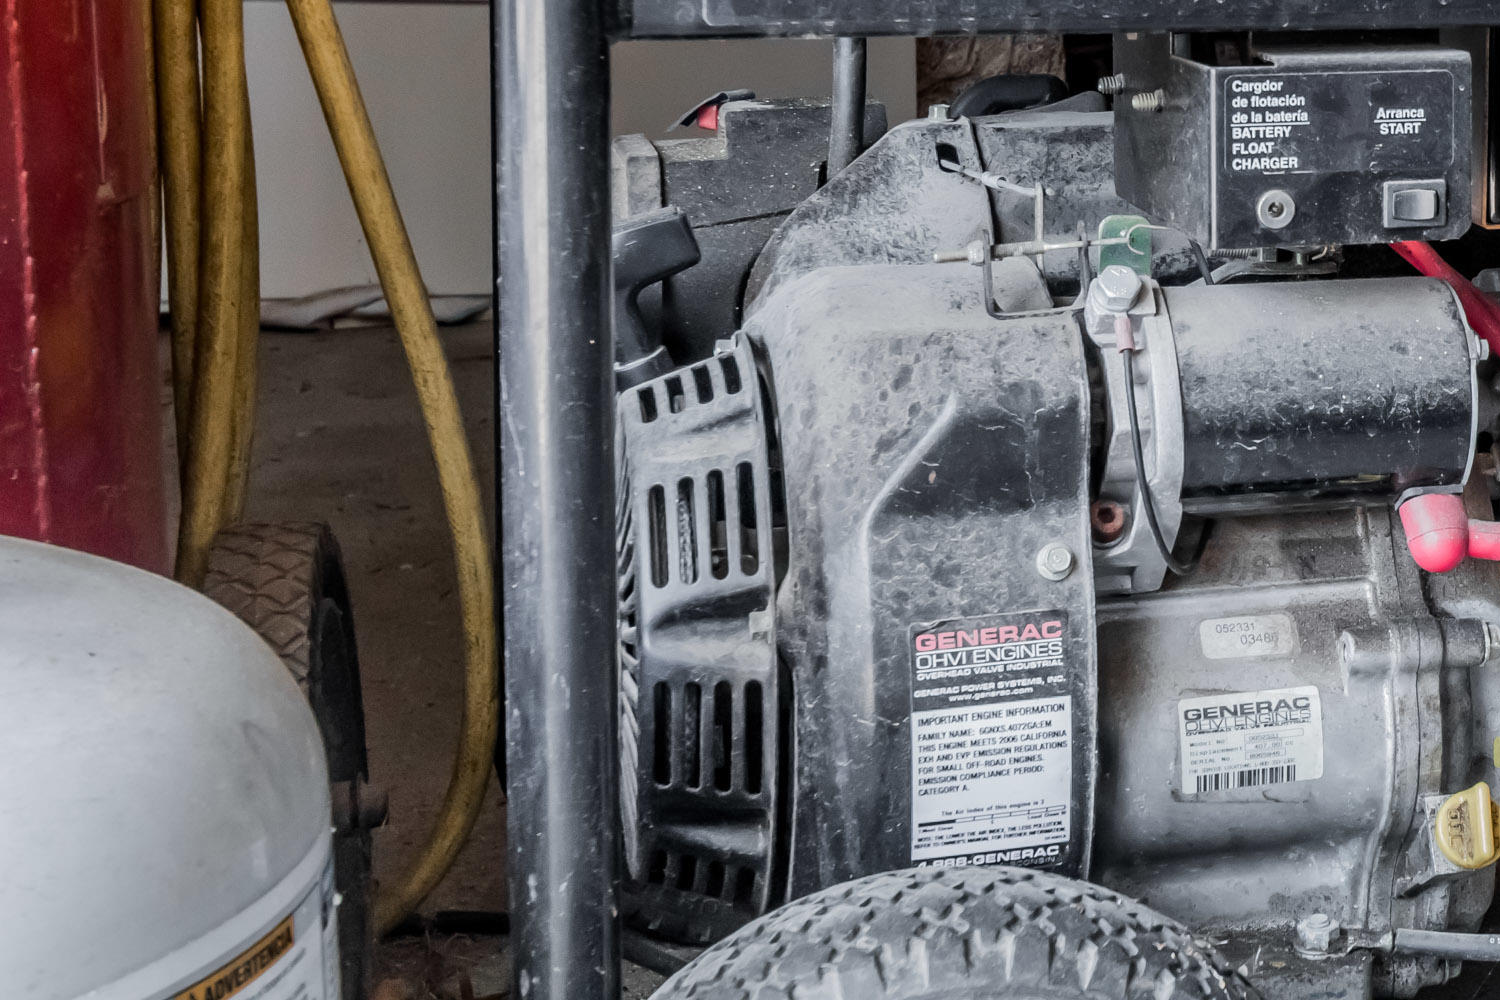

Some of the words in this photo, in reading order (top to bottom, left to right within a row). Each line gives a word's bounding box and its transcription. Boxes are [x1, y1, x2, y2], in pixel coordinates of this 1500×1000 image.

[1231, 80, 1283, 95] Cargdor
[1231, 96, 1248, 108] de
[1250, 94, 1306, 108] flotación
[1231, 111, 1248, 123] de
[1250, 111, 1263, 123] la
[1265, 109, 1309, 123] batería
[1376, 107, 1425, 119] Arranca
[1231, 126, 1292, 139] BATTERY
[1379, 122, 1422, 135] START
[1231, 141, 1275, 155] FLOAT
[1231, 157, 1298, 170] CHARGER
[915, 620, 1062, 652] GENERAC
[916, 652, 967, 670] OHVI
[973, 642, 1063, 664] ENGINES
[916, 669, 971, 682] OVERHEAD
[973, 664, 1005, 675] VALVE
[1006, 658, 1064, 672] INDUSTRIAL
[914, 685, 960, 698] GENERAC
[961, 682, 996, 693] POWER
[948, 686, 1034, 702] www.generac.com
[918, 714, 969, 727] IMPORTANT
[971, 709, 1004, 720] ENGINE
[1006, 703, 1065, 718] INFORMATION
[1184, 696, 1311, 721] GENERAC
[1234, 709, 1312, 729] ENGINES
[918, 731, 946, 742] FAMILY
[918, 744, 936, 753] THIS
[938, 741, 967, 751] ENGINE
[970, 737, 997, 747] MEETS
[1020, 729, 1068, 742] CALIFORNIA
[936, 753, 953, 763] AND
[973, 747, 1012, 758] EMISSION
[1014, 740, 1068, 753] REGULATIONS
[918, 766, 934, 775] FOR
[936, 763, 963, 774] SMALL
[918, 775, 957, 787] EMISSION
[960, 769, 1011, 782] COMPLIANCE
[918, 785, 959, 797] CATEGORY
